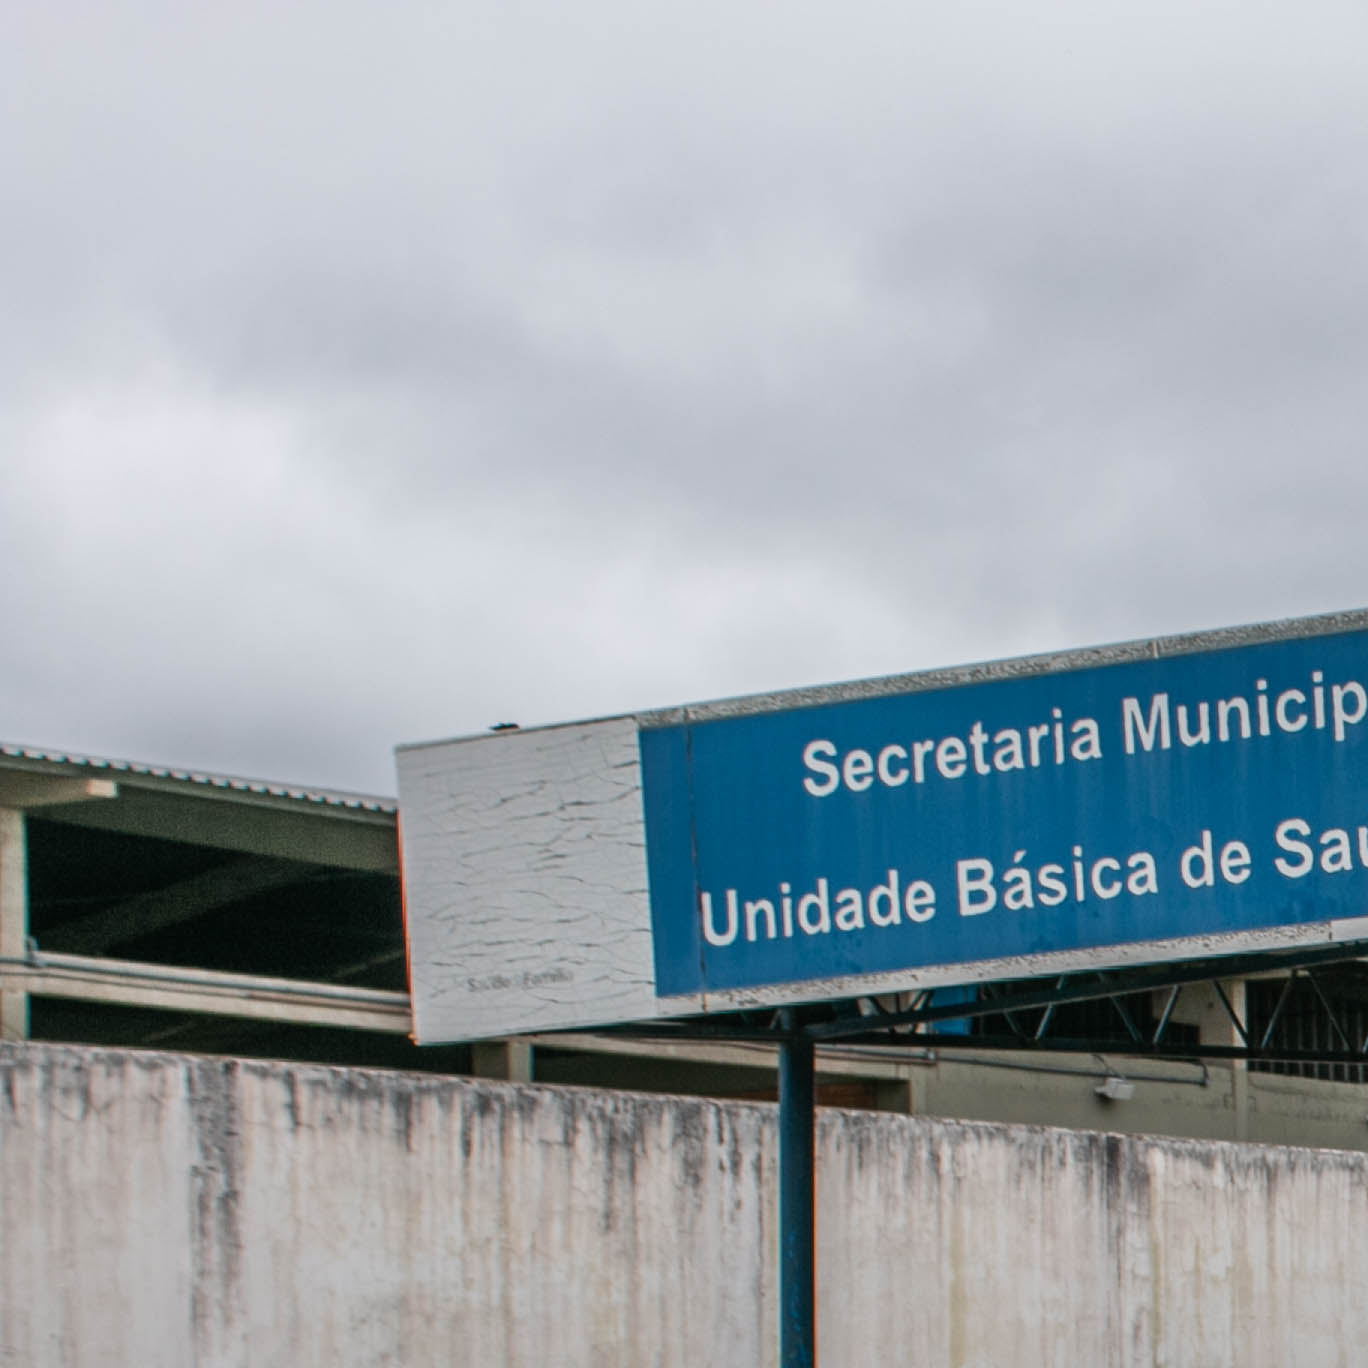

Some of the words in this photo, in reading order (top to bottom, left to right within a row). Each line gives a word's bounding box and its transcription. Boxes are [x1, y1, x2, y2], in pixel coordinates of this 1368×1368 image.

[804, 709, 1101, 796] Secretaria
[702, 870, 934, 945] Unidade
[957, 846, 1157, 915] Básica
[1181, 830, 1250, 888] de
